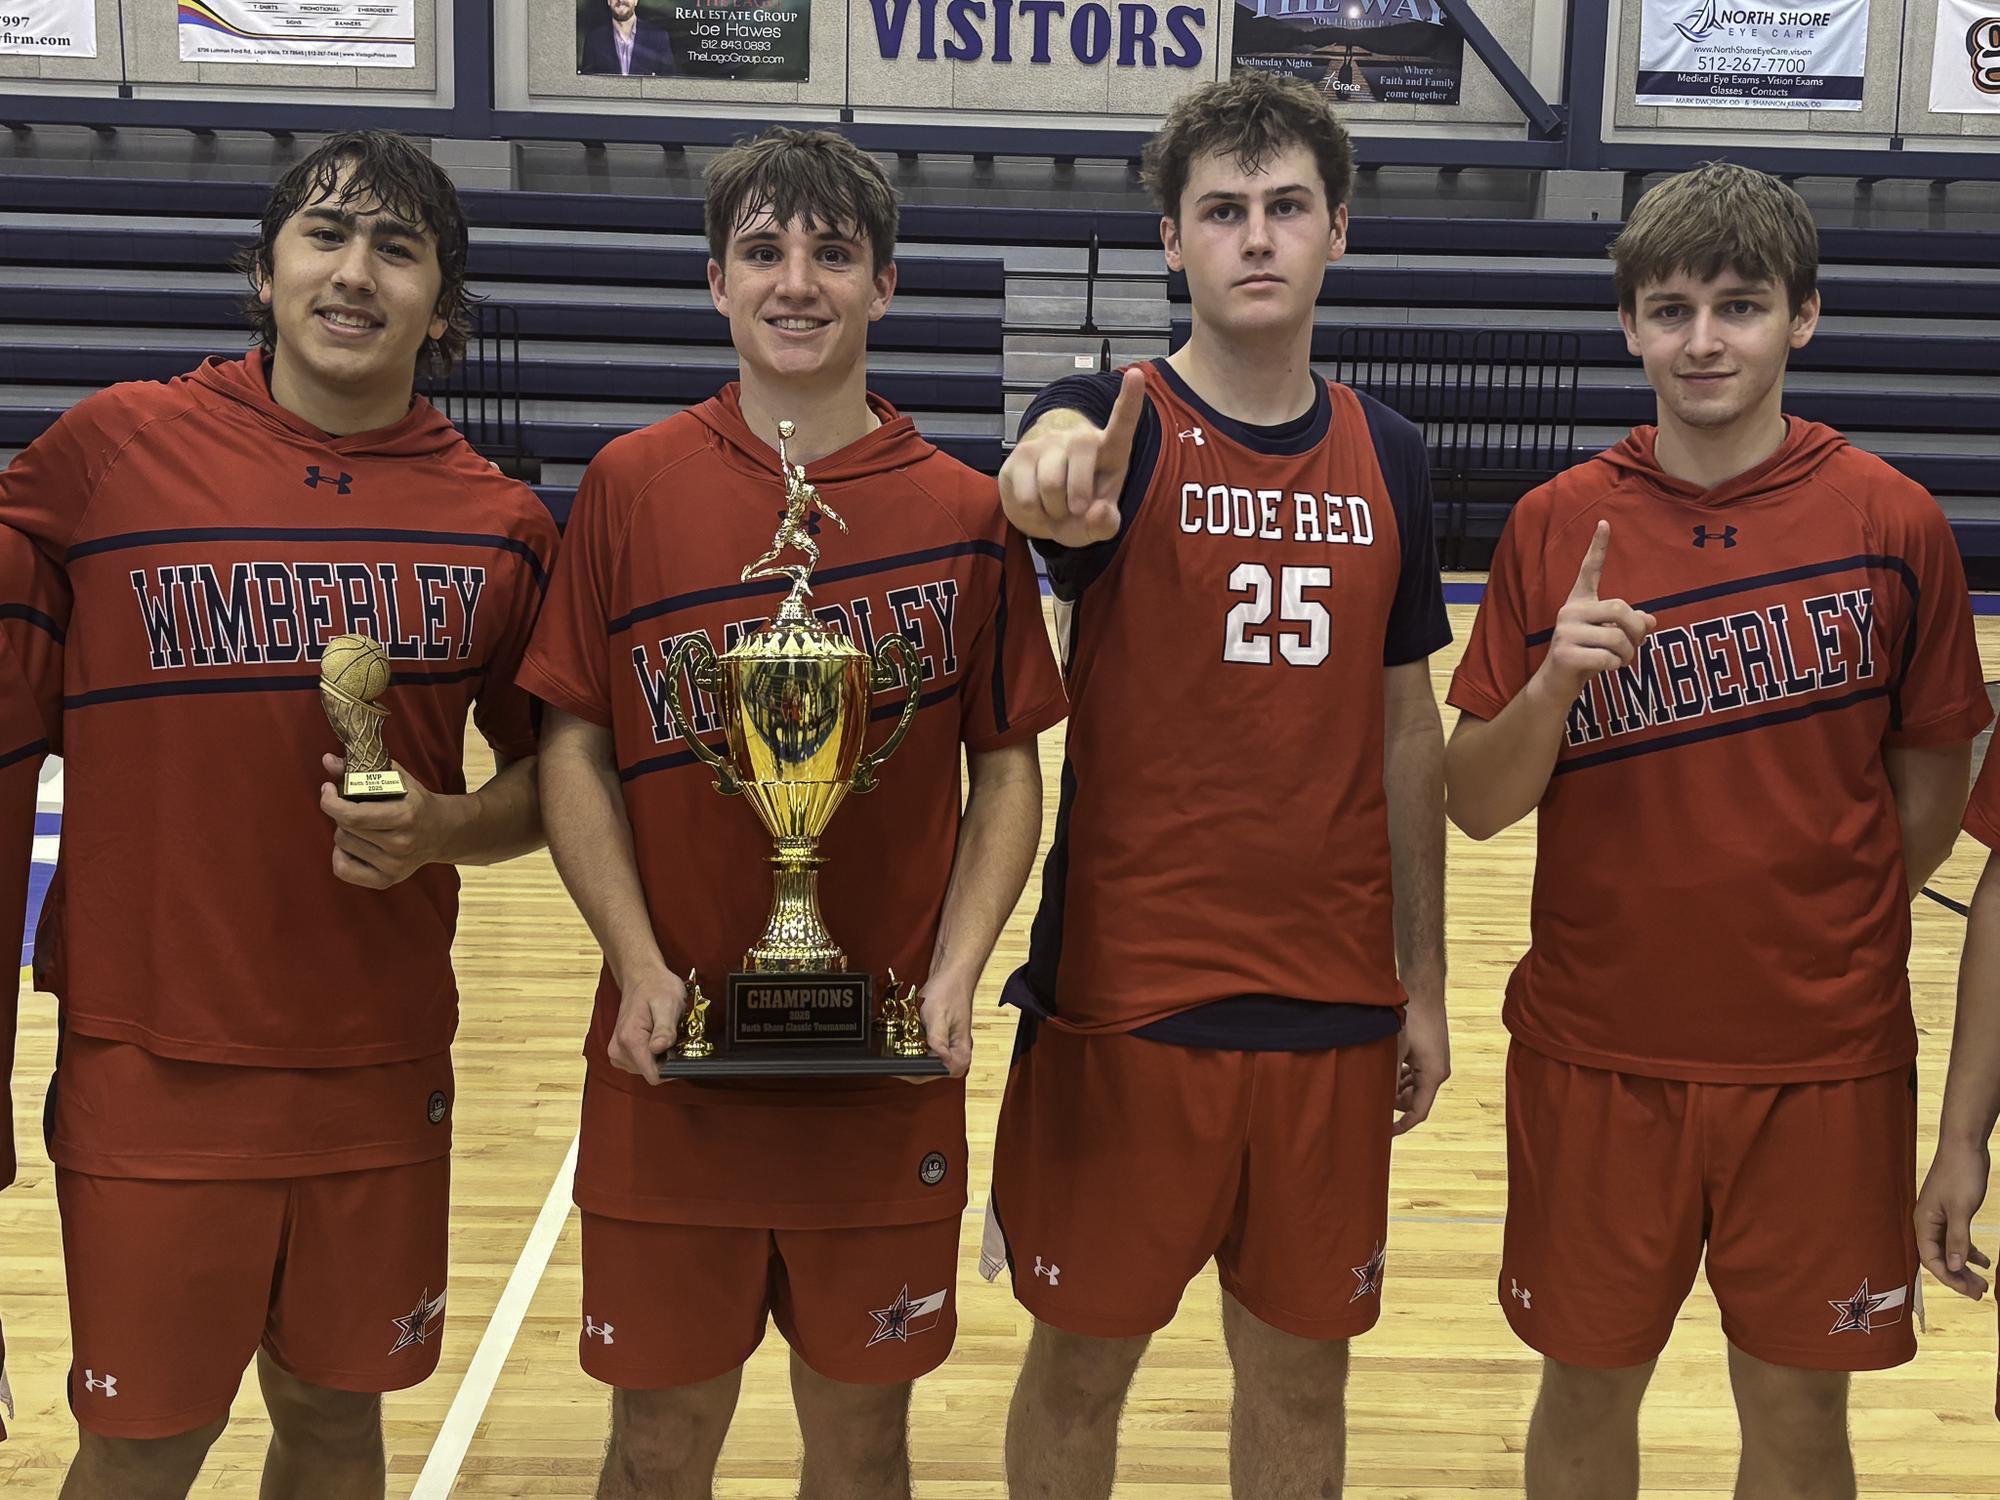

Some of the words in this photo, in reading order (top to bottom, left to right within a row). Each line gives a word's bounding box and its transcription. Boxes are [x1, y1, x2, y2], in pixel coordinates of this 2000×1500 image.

[675, 7, 706, 20] REAL
[709, 10, 751, 20] ESTATE
[753, 9, 798, 22] GROUP
[1721, 9, 1774, 25] NORTH
[1778, 12, 1831, 27] SHORE
[0, 16, 30, 28] 997
[690, 21, 720, 36] Joe
[726, 22, 781, 38] Hawes
[870, 0, 1206, 69] VISITORS
[1728, 27, 1757, 37] EYE
[1771, 29, 1815, 39] CARE
[0, 32, 71, 46] firm.com
[701, 39, 771, 51] 512.843.0893
[1693, 45, 1813, 57] www.NorthShoreEyeCare.vision
[1236, 56, 1284, 68] Wednesday
[1286, 58, 1313, 69] Nights
[1698, 56, 1806, 73] 512-267-7700
[1404, 65, 1434, 75] Where
[1332, 80, 1361, 92] Grace
[1380, 75, 1403, 85] Faith
[1405, 77, 1422, 86] and
[1425, 78, 1455, 90] Family
[1677, 73, 1711, 83] Medical
[1714, 75, 1729, 85] Eye
[1731, 75, 1760, 84] Exams
[1767, 76, 1793, 85] Vision
[1795, 77, 1824, 86] Exams
[1411, 91, 1448, 101] together
[1710, 86, 1743, 95] Glasses
[1750, 87, 1789, 97] Contacts
[1178, 482, 1283, 541] CODE
[1292, 490, 1375, 546] RED
[130, 562, 486, 669] WIMBERLEY
[1221, 562, 1333, 667] 25
[747, 988, 854, 1009] CHAMPIONS
[789, 1010, 810, 1020] 2025
[741, 1023, 760, 1033] North
[763, 1023, 784, 1032] Shore
[785, 1022, 812, 1032] Classic
[813, 1022, 857, 1032] Tournament
